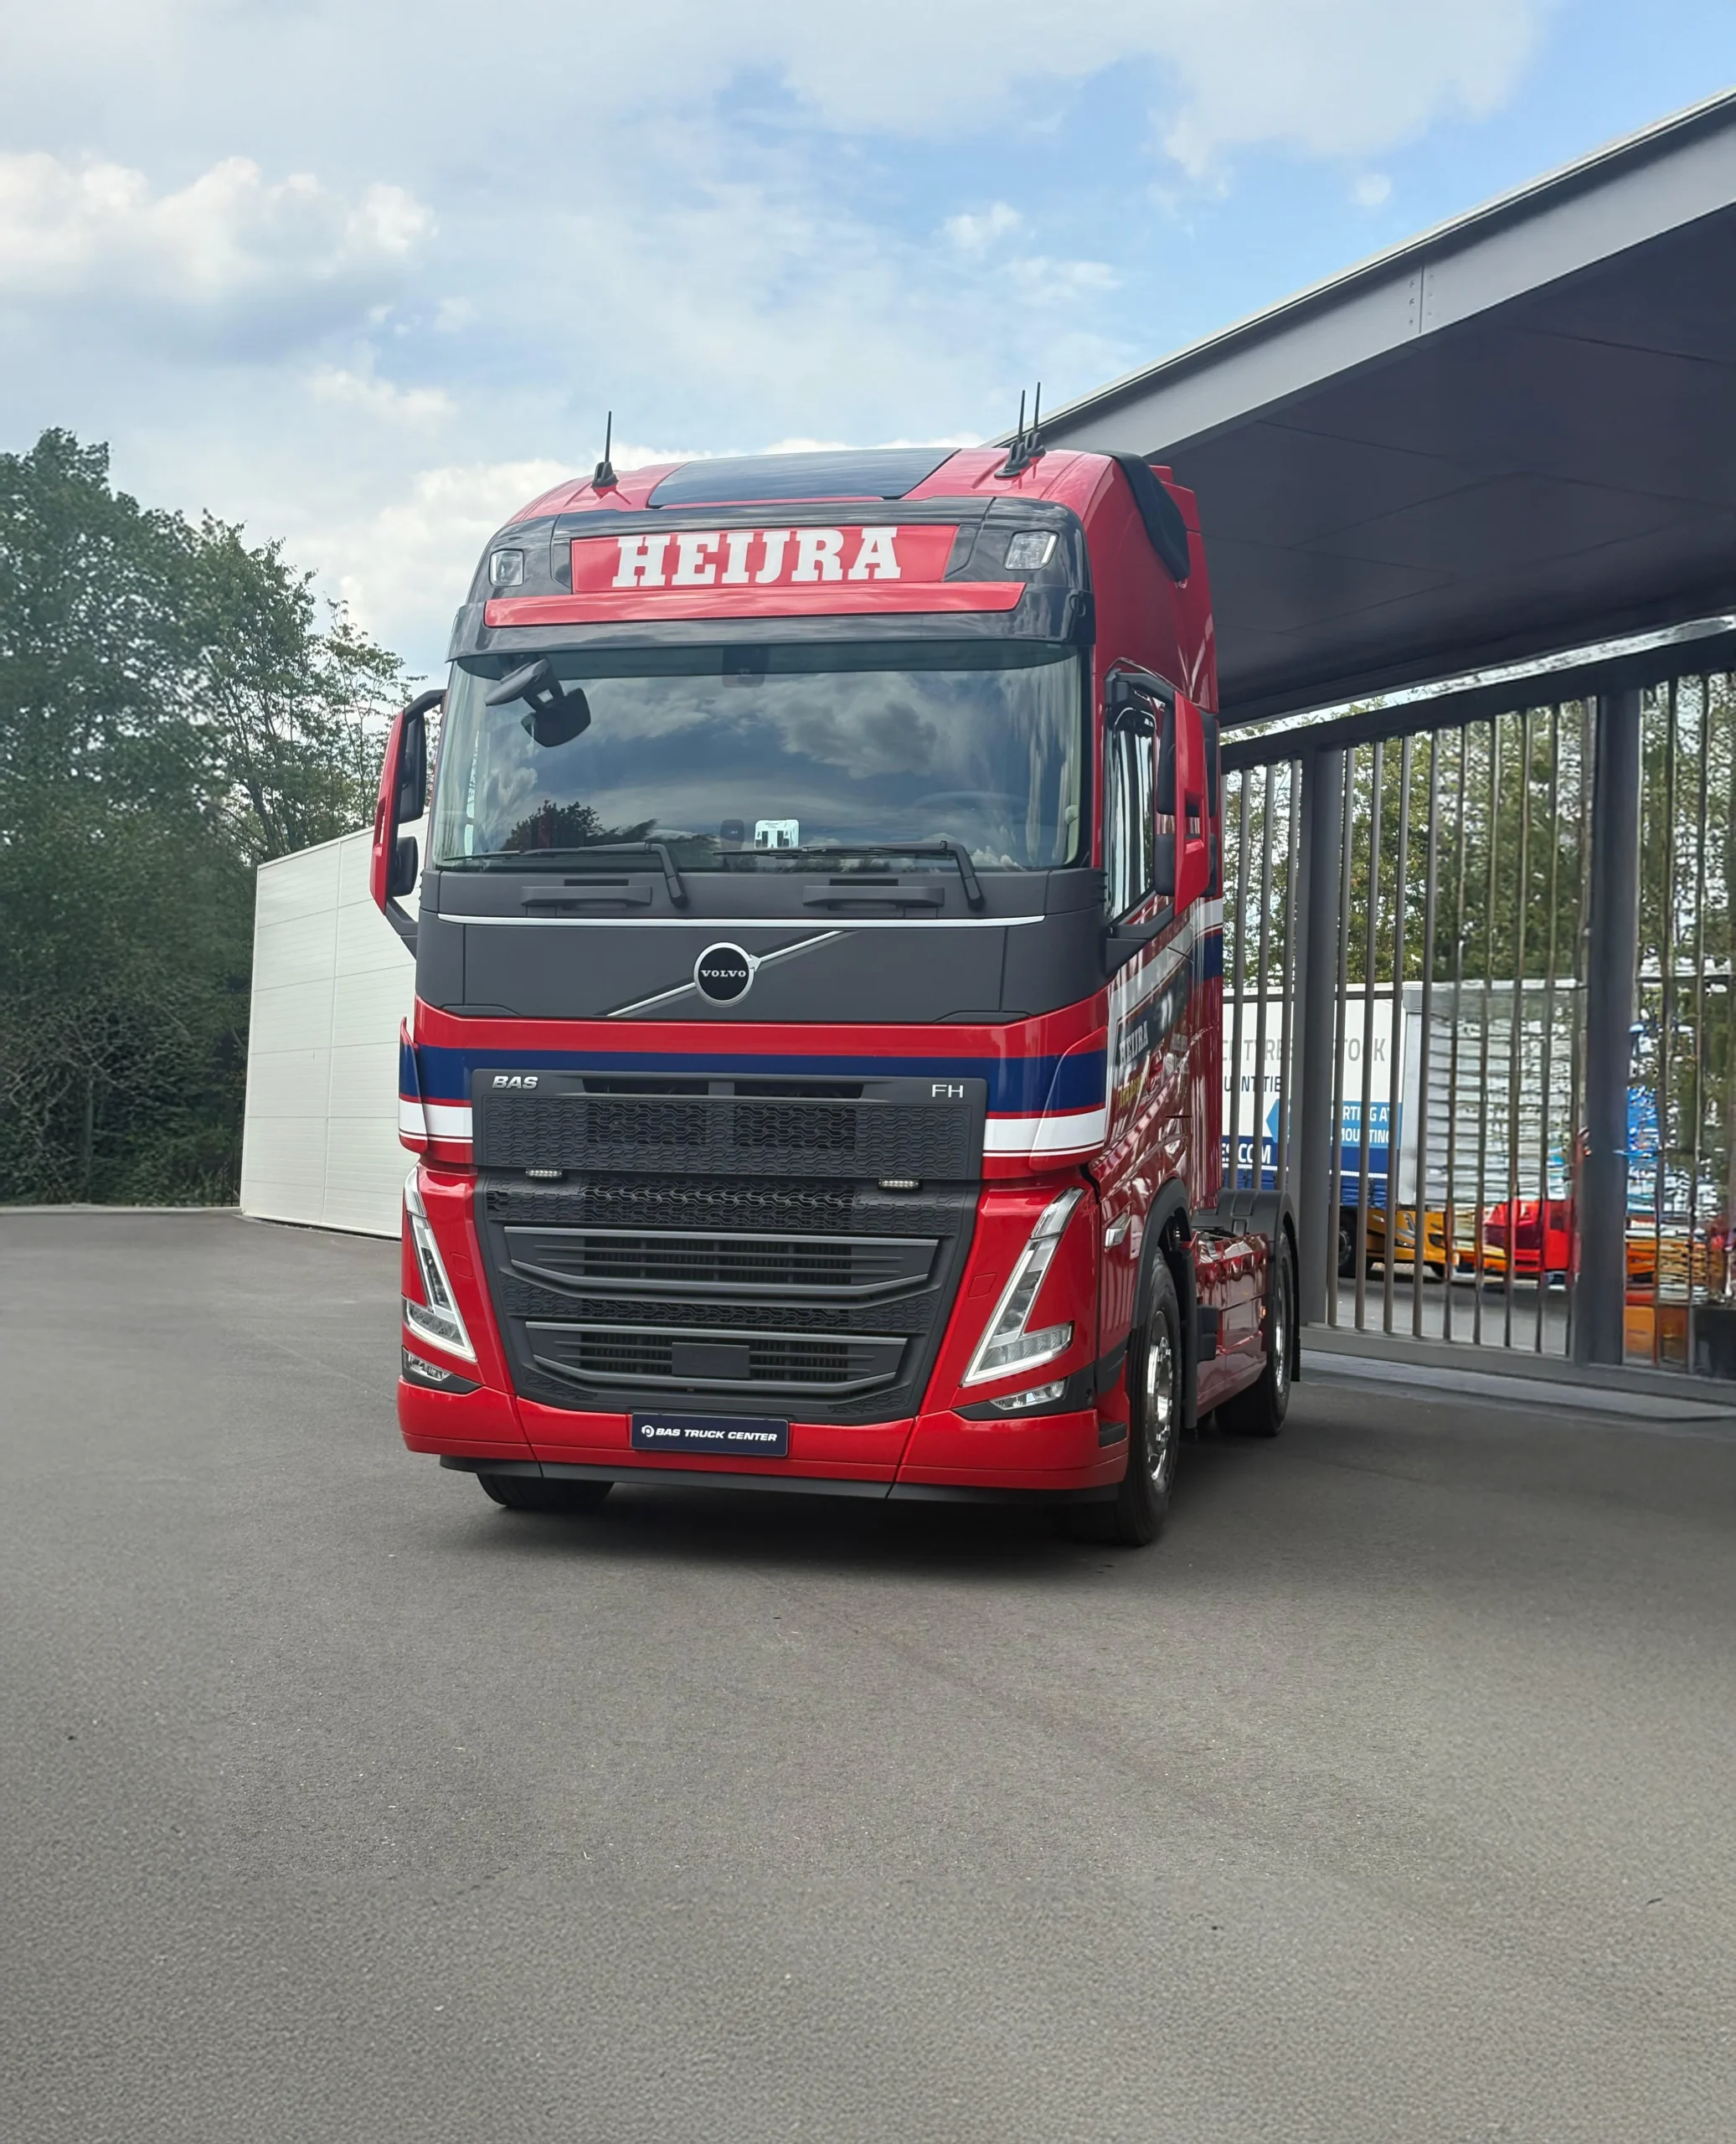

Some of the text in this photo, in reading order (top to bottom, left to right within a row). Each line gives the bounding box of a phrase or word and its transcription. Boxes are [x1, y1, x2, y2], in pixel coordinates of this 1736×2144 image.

[612, 528, 901, 587] HEIJRA
[492, 1075, 538, 1090] BAS
[932, 1084, 963, 1098] FH
[656, 1428, 778, 1441] BAS TRUCK CENTER
